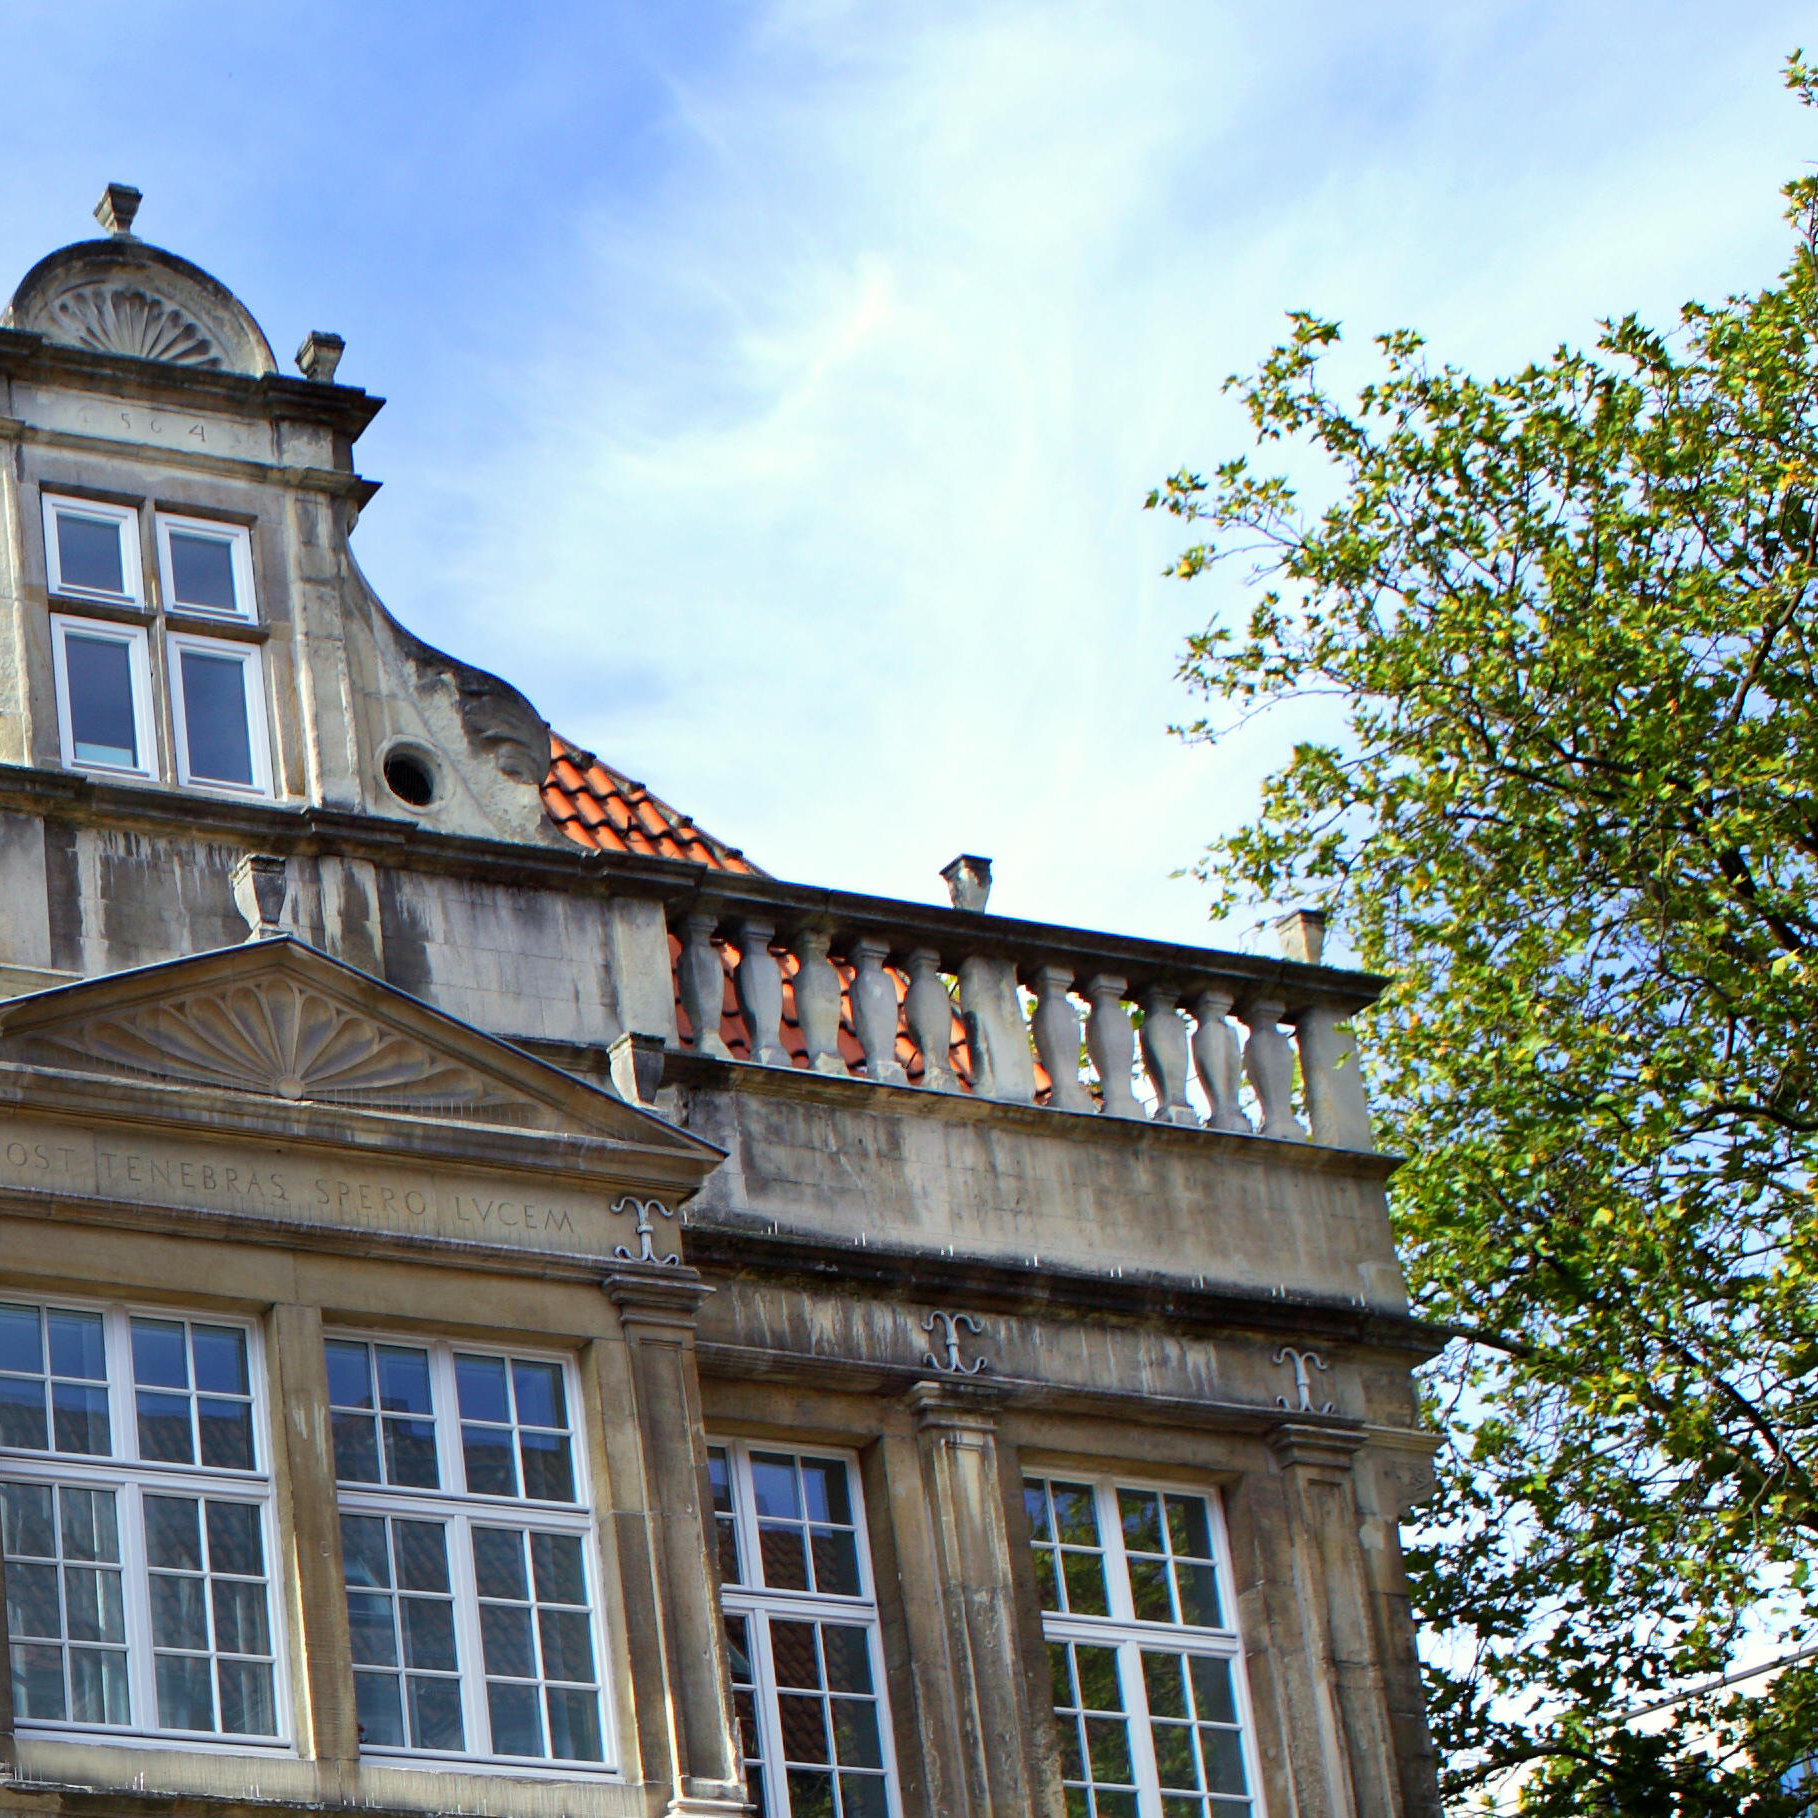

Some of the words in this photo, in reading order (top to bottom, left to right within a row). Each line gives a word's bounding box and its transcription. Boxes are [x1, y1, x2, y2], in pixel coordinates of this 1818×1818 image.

[100, 1152, 288, 1201] TENEBRAS
[314, 1178, 427, 1216] SPERO
[454, 1196, 575, 1234] LVCEM
